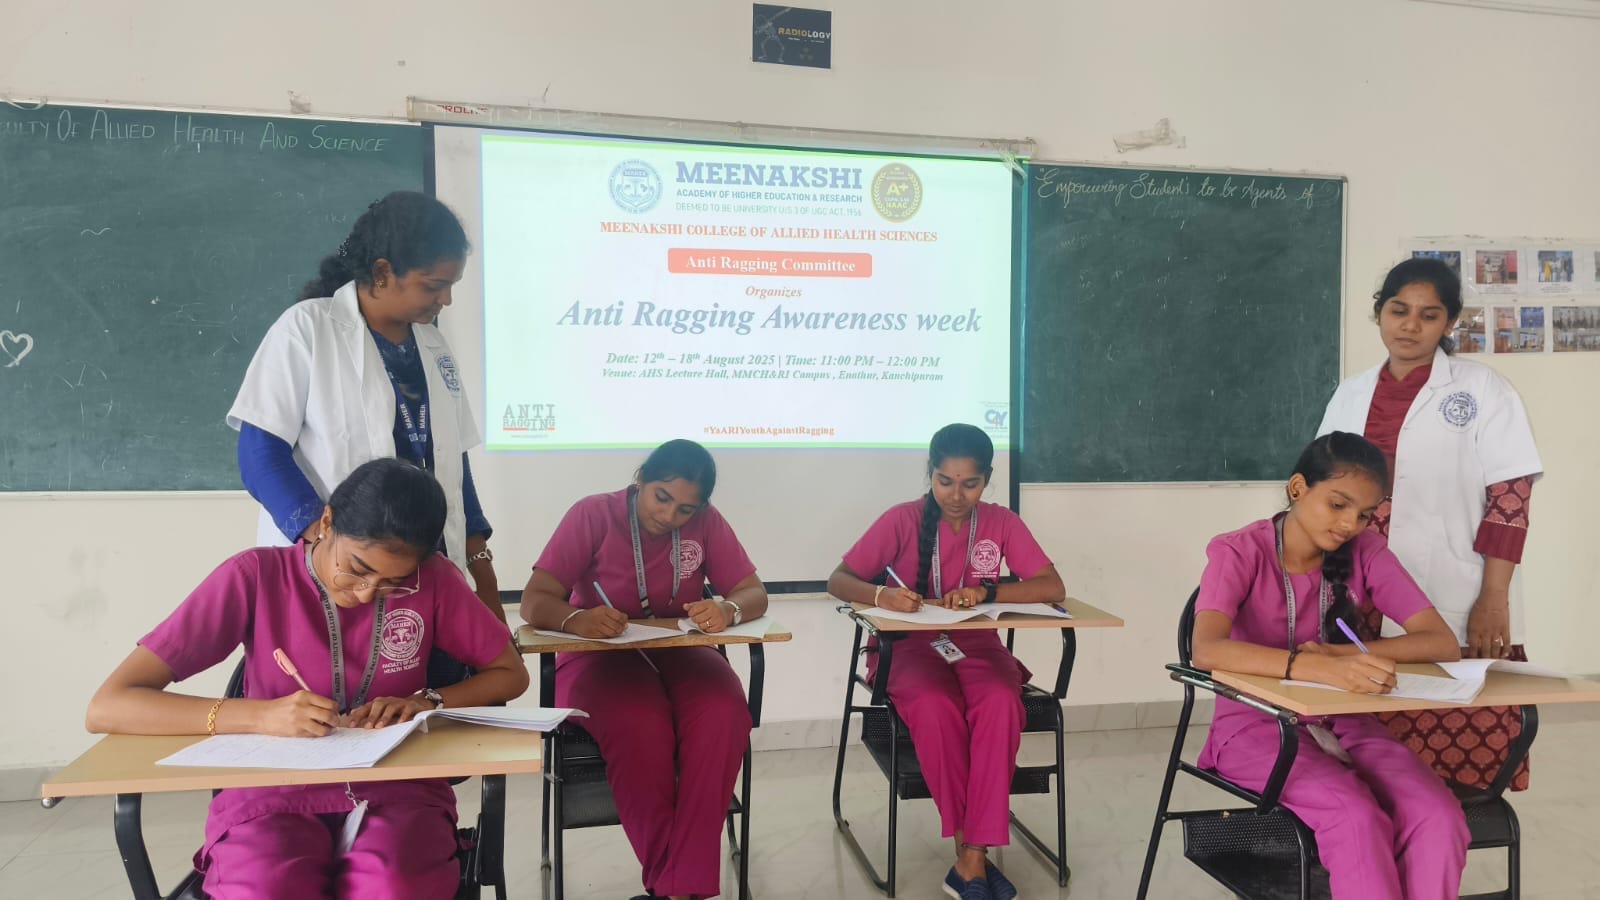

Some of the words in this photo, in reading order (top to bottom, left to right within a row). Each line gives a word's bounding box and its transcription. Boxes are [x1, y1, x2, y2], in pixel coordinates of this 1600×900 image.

[778, 27, 831, 39] RADIOLOGY
[90, 109, 155, 140] ALLIED
[174, 115, 244, 145] HEALTH
[259, 121, 298, 150] AND
[308, 124, 389, 151] SCIENCE
[676, 161, 862, 189] MEENAKSHI
[676, 189, 716, 198] ACADEMY
[720, 190, 729, 198] OF
[732, 191, 762, 200] HIGHER
[764, 192, 810, 201] EDUCATION
[820, 194, 862, 203] RESEARCH
[886, 181, 909, 196] A+
[1197, 176, 1216, 196] to
[1220, 176, 1237, 197] be
[1241, 179, 1287, 208] Agents
[1297, 183, 1314, 209] of
[676, 202, 708, 211] DEEMED
[711, 203, 720, 212] TO
[722, 204, 732, 212] BE
[734, 204, 776, 213] UNIVERSITY
[800, 206, 809, 214] OF
[600, 222, 682, 235] MEENAKSHI
[687, 224, 746, 237] COLLEGE
[750, 226, 767, 237] OF
[770, 228, 820, 239] ALLIED
[823, 229, 876, 240] HEALTH
[880, 230, 938, 242] SCIENCES
[687, 256, 716, 269] Anti
[721, 257, 777, 272] Ragging
[782, 259, 855, 272] Committee
[745, 286, 802, 299] Organizes
[556, 300, 625, 326] Anti
[632, 301, 755, 335] Ragging
[760, 304, 908, 331] Awareness
[917, 308, 983, 332] week
[606, 353, 639, 364] Date:
[643, 352, 664, 364] 12th
[680, 352, 700, 364] 18th
[703, 354, 745, 367] August
[747, 355, 775, 365] 2025
[785, 355, 816, 366] Time:
[821, 355, 851, 366] 11:00
[854, 355, 874, 366] PM
[887, 356, 917, 367] 12:00
[920, 357, 941, 367] PM
[602, 369, 637, 378] Venue:
[638, 369, 663, 378] AHS
[665, 369, 703, 378] Lecture
[705, 369, 729, 380] Hall,
[731, 370, 790, 379] MMCH&RI
[792, 370, 830, 381] Campus
[881, 371, 944, 382] Kanchipuram
[503, 403, 555, 418] ANTI
